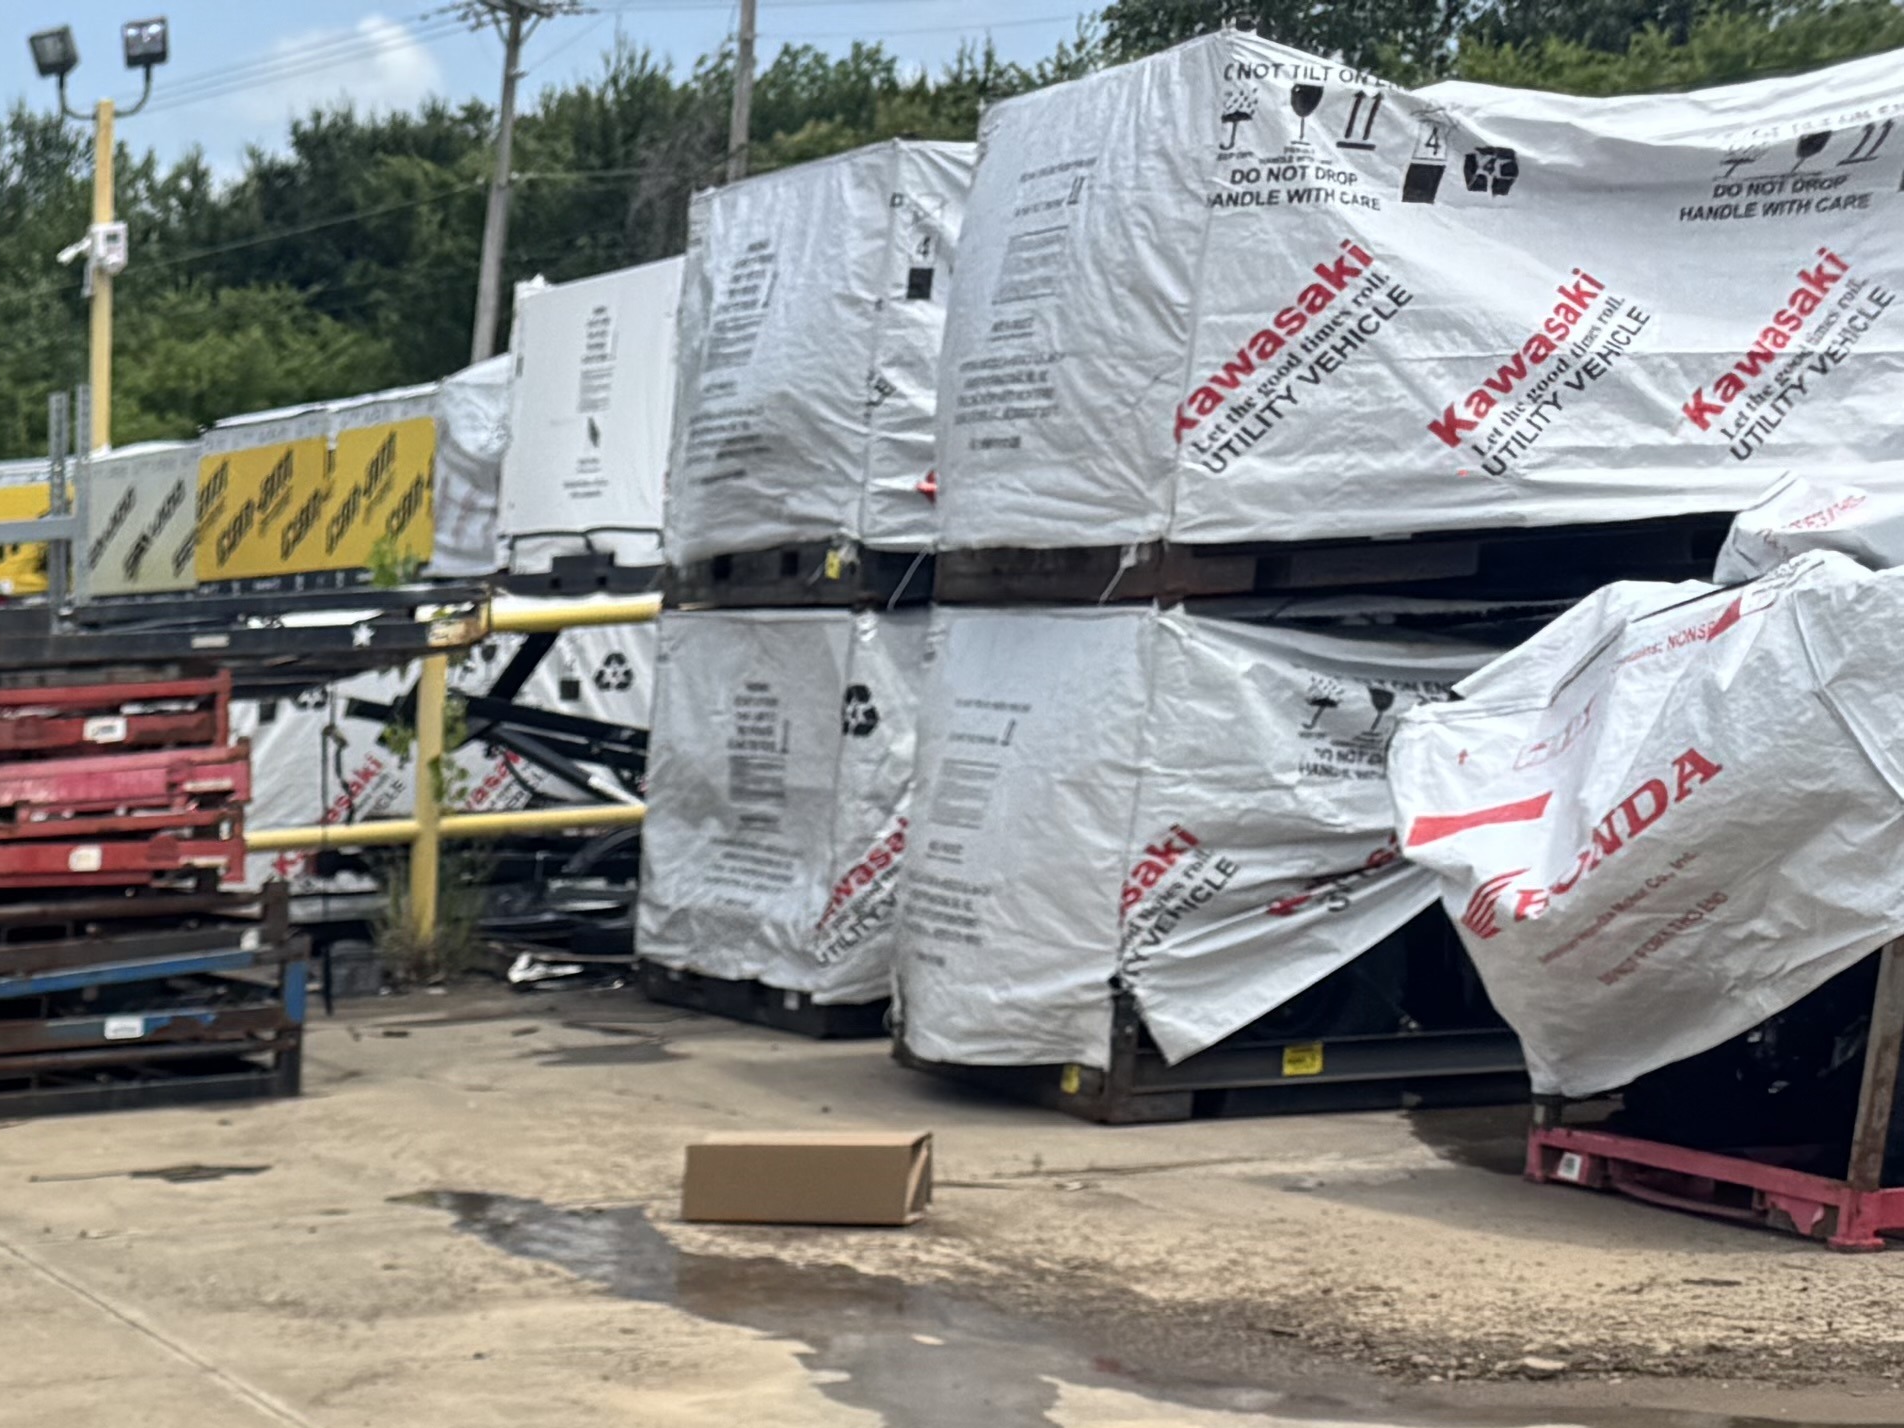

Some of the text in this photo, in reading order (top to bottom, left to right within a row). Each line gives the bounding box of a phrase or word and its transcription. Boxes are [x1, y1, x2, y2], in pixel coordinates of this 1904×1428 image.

[1292, 64, 1336, 81] TILT
[1206, 187, 1381, 211] ANDLE WITH CARE
[1230, 165, 1359, 186] DO NOT DROP
[1679, 191, 1873, 221] HANDLE WITH CARE
[1712, 174, 1851, 199] DO NOT DROP
[1202, 284, 1413, 474] UTILITY VEHICLE
[1427, 268, 1605, 448] Kawasaki
[1682, 247, 1851, 431] Kawasaki
[1729, 374, 1808, 461] UTILITY
[1808, 285, 1896, 375] VEHICLE
[1191, 423, 1228, 454] Let
[1226, 396, 1259, 424] the
[1257, 351, 1303, 397] good
[1471, 428, 1504, 457] Let
[1500, 400, 1527, 426] the
[1526, 357, 1570, 403] good
[1481, 306, 1650, 476] UTILITY VEHICLE
